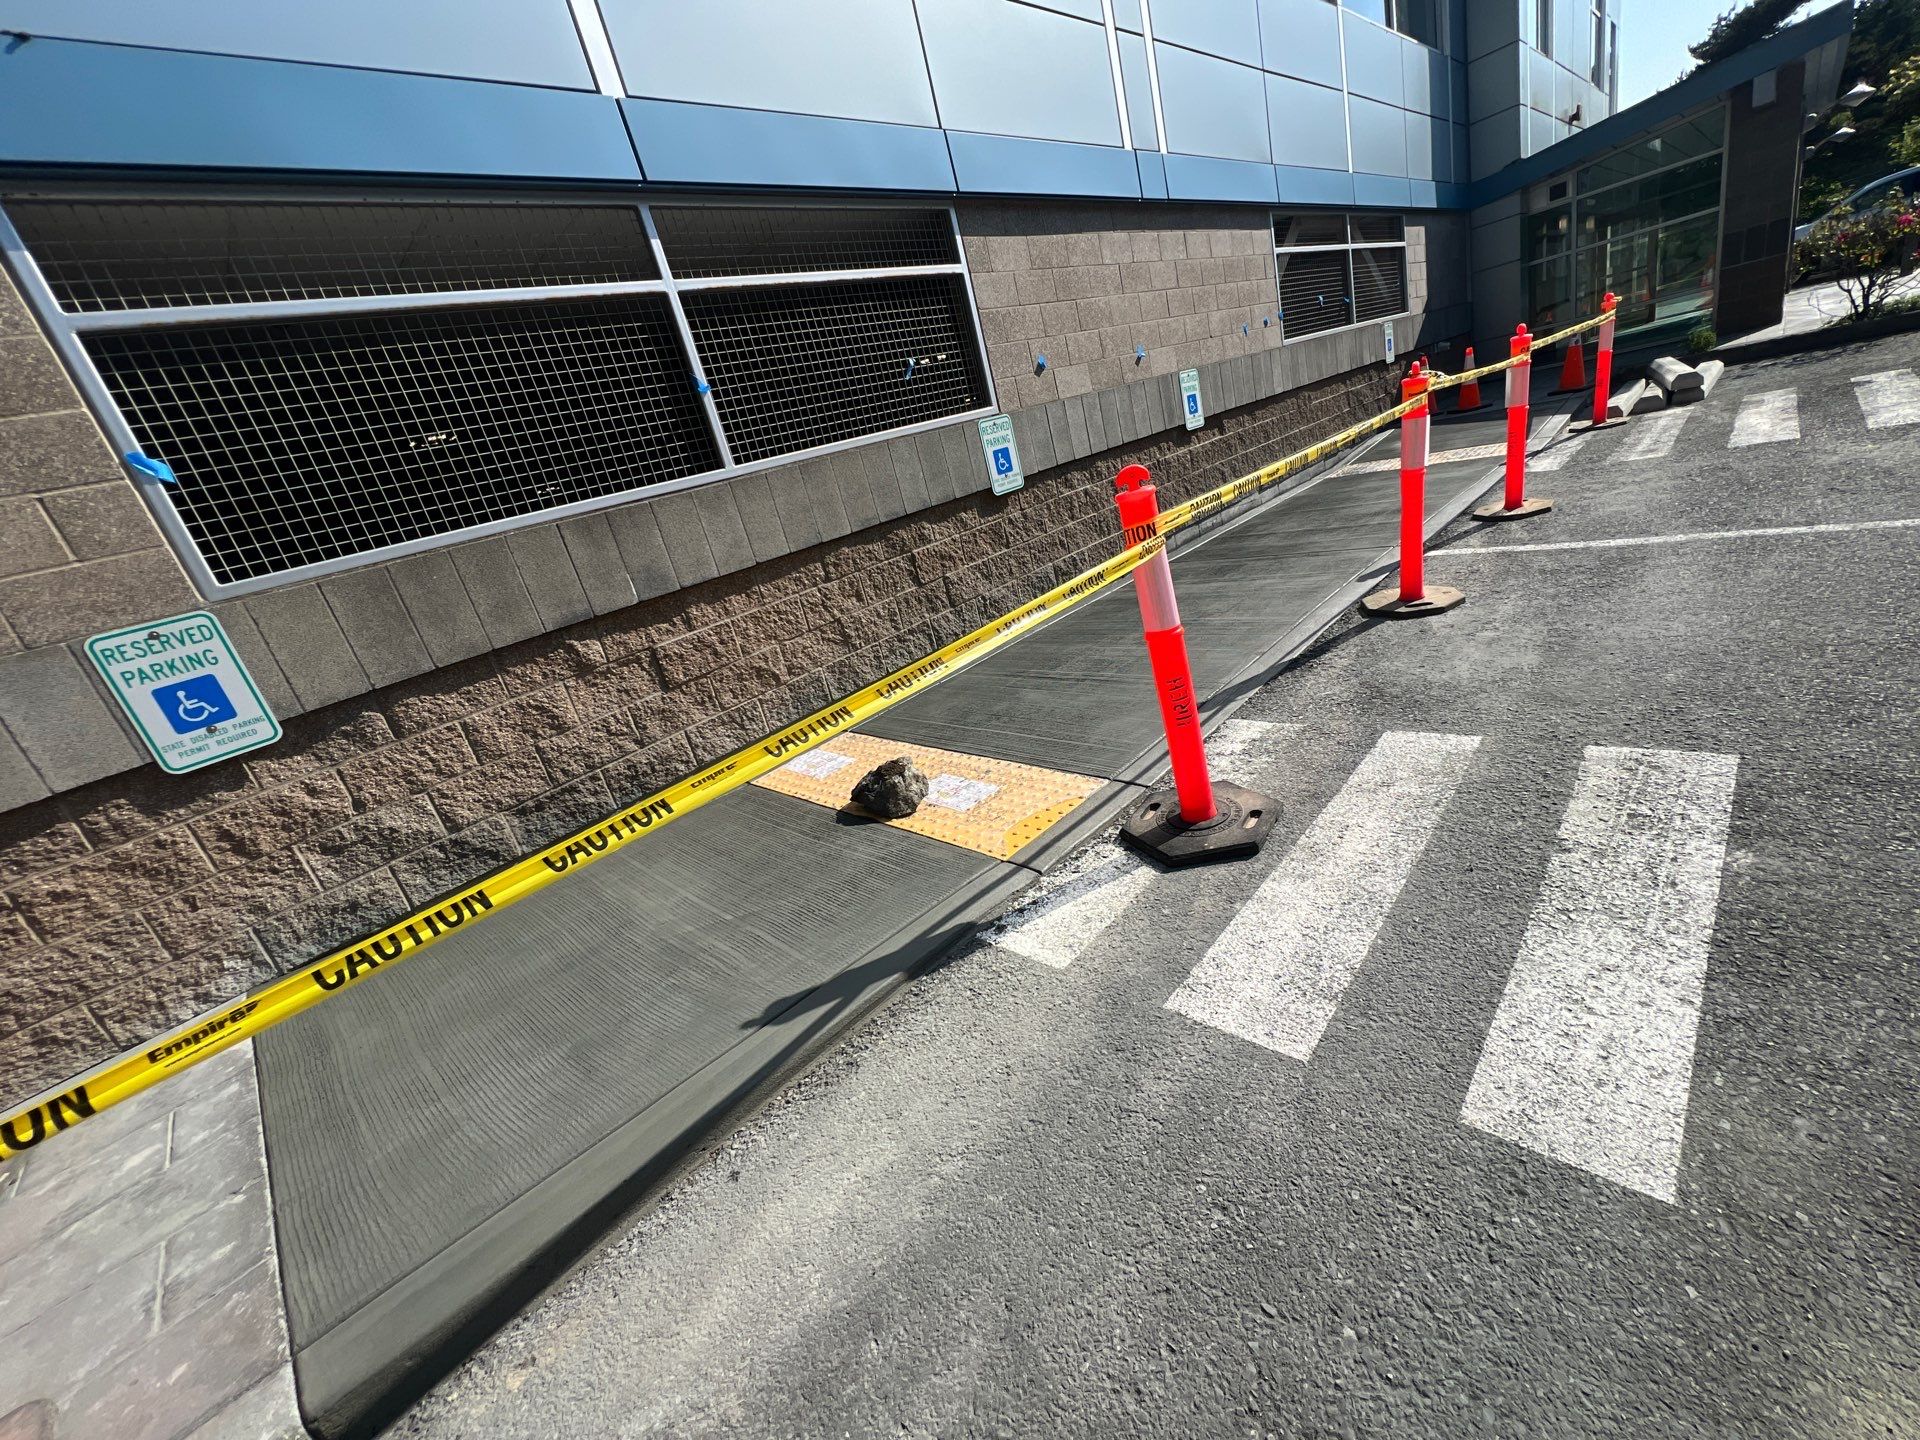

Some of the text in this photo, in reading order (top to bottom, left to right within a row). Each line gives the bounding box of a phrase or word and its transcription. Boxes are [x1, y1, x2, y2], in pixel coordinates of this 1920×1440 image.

[981, 420, 1011, 435] RESERVED
[986, 434, 1011, 448] PARKING
[100, 624, 215, 667] RESERVED
[120, 649, 219, 688] PARKING
[161, 741, 187, 754] STATE
[232, 715, 265, 731] PARKING
[178, 728, 258, 759] PERMIT REQUIRED
[541, 798, 674, 873] CAUTION
[312, 889, 494, 991] CAUTION
